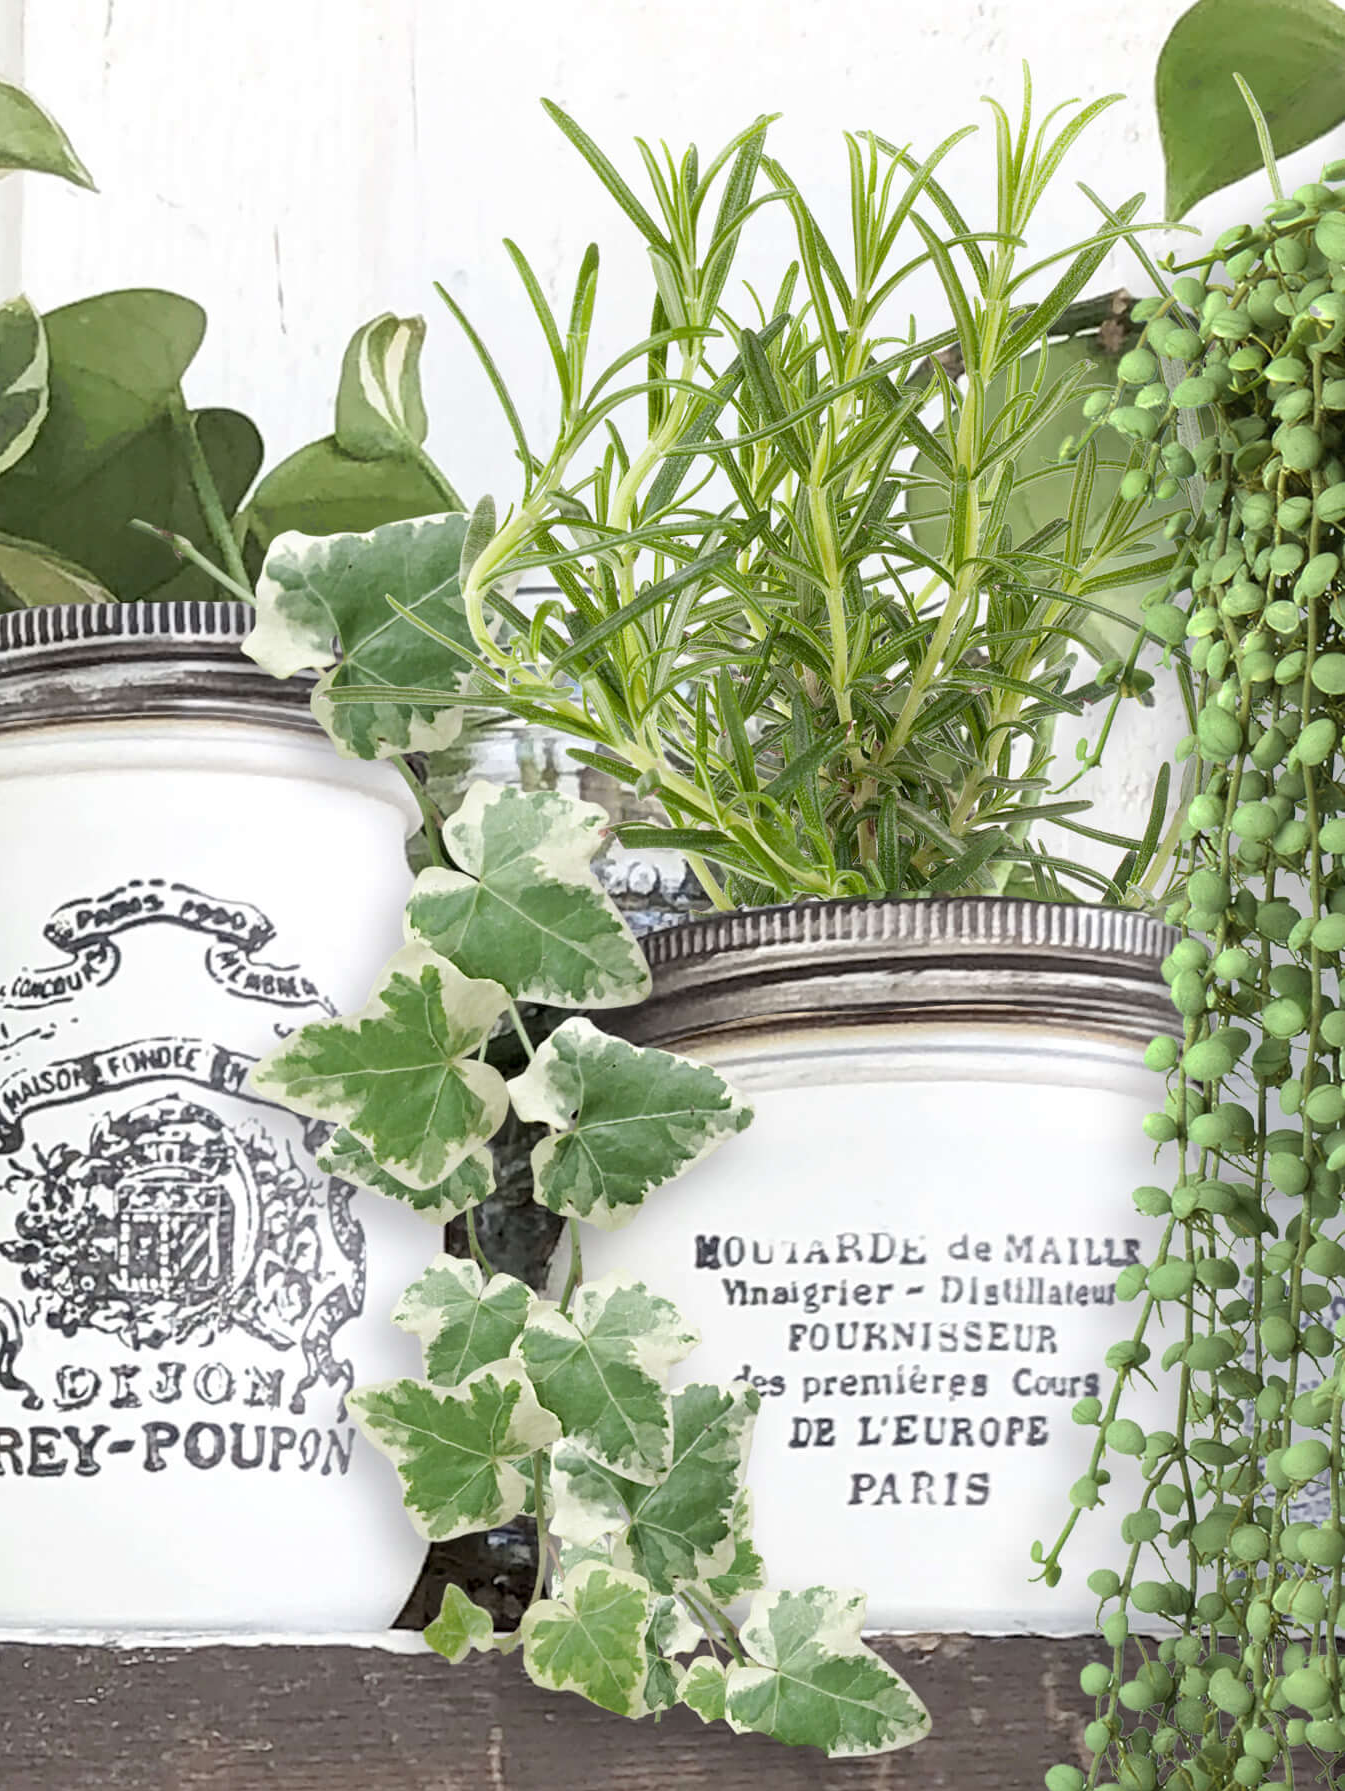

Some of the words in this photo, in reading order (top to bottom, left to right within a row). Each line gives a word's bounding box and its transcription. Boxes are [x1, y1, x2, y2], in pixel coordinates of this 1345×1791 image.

[947, 1233, 992, 1262] de
[788, 1320, 1058, 1353] FOURNISSEUR
[54, 1361, 285, 1411] DIJON
[1012, 1367, 1101, 1399] Cours
[788, 1416, 836, 1449] DE
[857, 1414, 1051, 1448] L'EUROPE
[847, 1471, 992, 1506] PARIS
